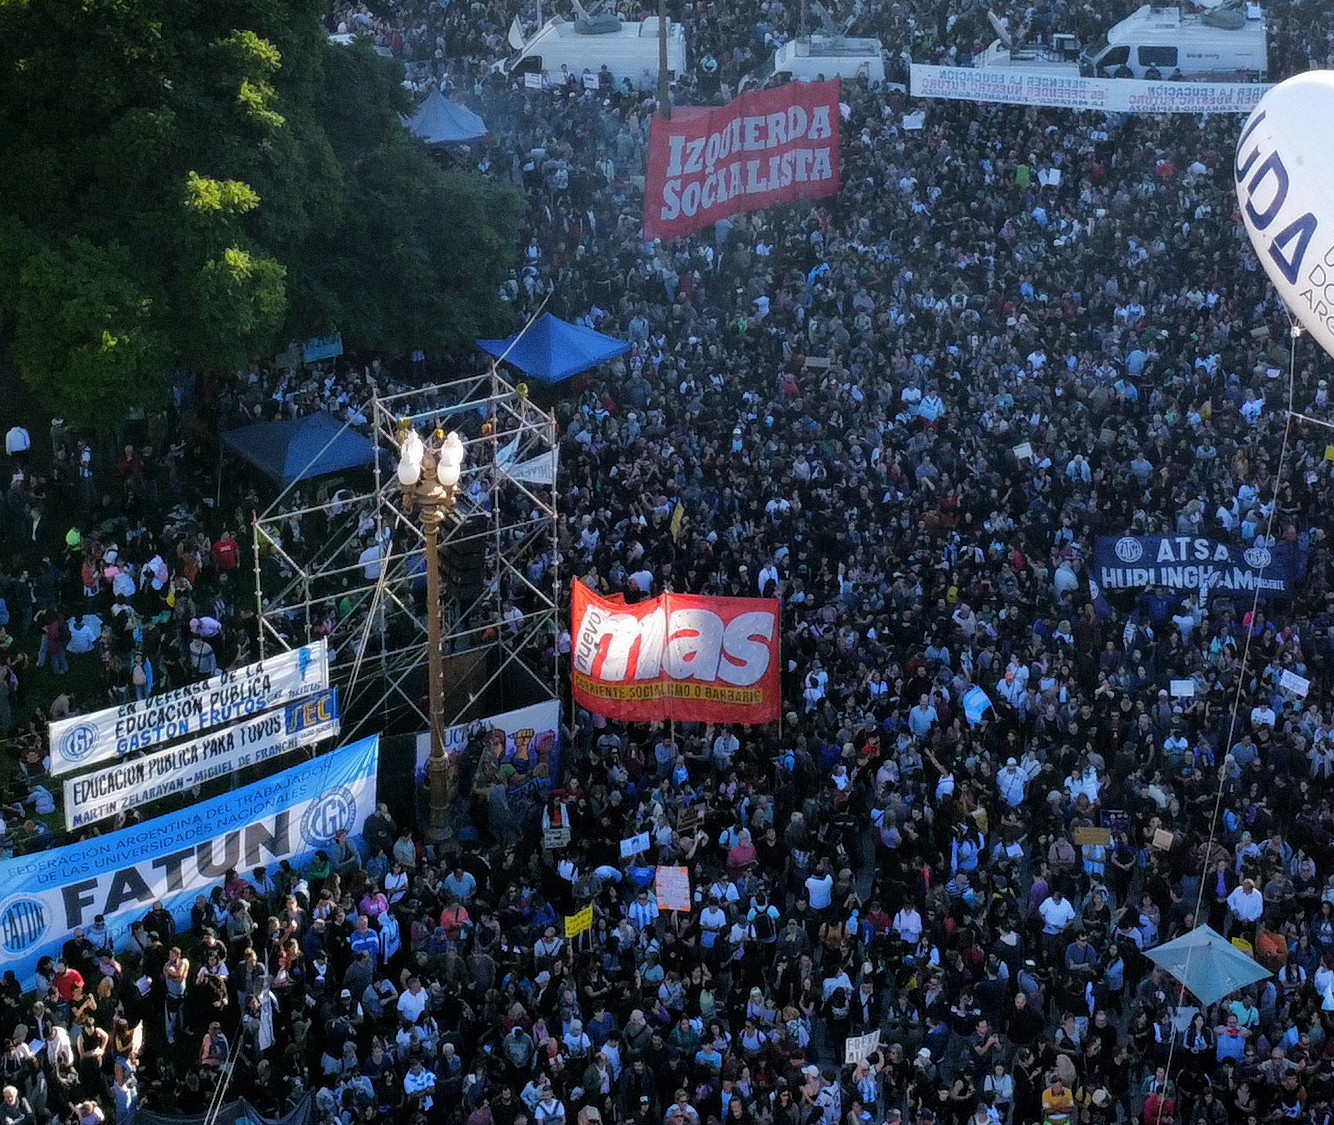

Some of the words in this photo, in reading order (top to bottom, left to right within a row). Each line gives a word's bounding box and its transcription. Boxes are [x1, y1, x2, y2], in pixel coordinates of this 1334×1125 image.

[666, 105, 832, 177] IZQUIERDA
[661, 147, 832, 221] SOCIALISTA
[1235, 110, 1318, 286] UDA
[574, 603, 776, 686] mas
[576, 611, 602, 671] nuevo
[118, 704, 137, 718] EN
[221, 669, 239, 685] DE
[246, 661, 264, 676] LA
[288, 696, 332, 732] SEC
[695, 684, 701, 697] O
[705, 687, 762, 704] BARBARIE
[117, 721, 189, 754] GASTON
[199, 696, 267, 732] FRUTOS
[116, 816, 203, 851] ARGENTINA
[206, 806, 232, 820] DEL
[234, 762, 333, 806] TRABAJADOR
[121, 777, 184, 809] ZELARAYAN
[238, 756, 251, 768] DE
[38, 869, 56, 884] DE
[60, 861, 90, 878] LAS
[93, 822, 214, 870] UNIVERSIDADES
[217, 784, 308, 827] NACIONALES
[60, 810, 292, 930] FATUN
[2, 902, 45, 949] FATUN
